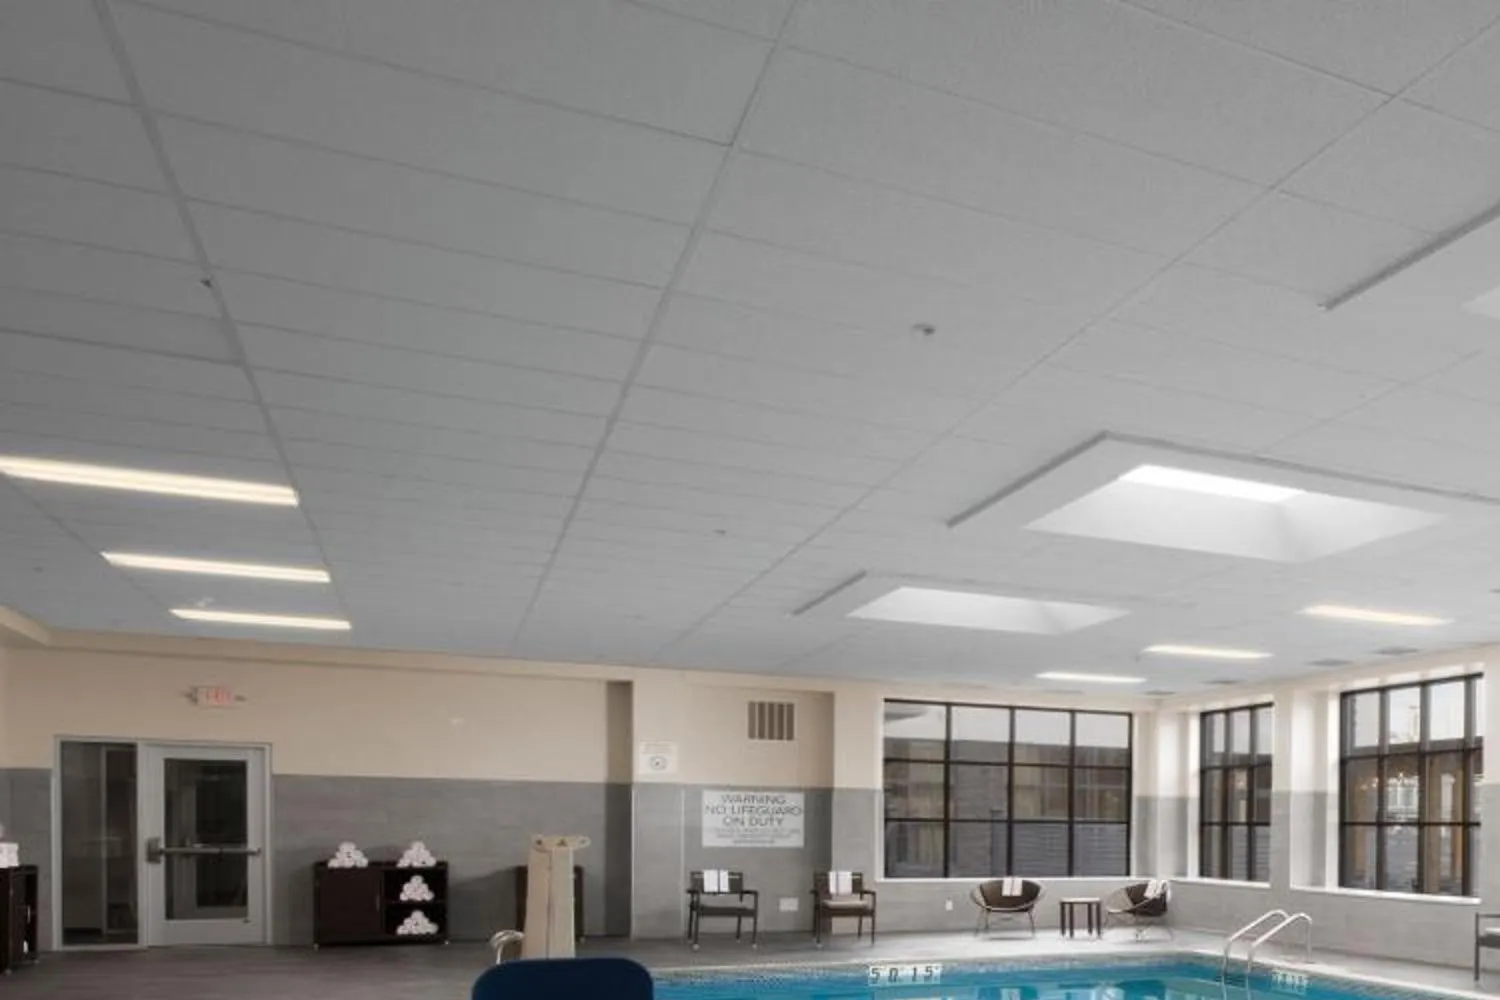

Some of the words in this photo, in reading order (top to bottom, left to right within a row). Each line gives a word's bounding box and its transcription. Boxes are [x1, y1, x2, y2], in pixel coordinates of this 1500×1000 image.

[719, 793, 786, 805] WARNING
[705, 805, 727, 815] NO
[731, 805, 802, 816] LIFEGUARD
[723, 816, 744, 826] ON
[749, 816, 784, 827] DUTY
